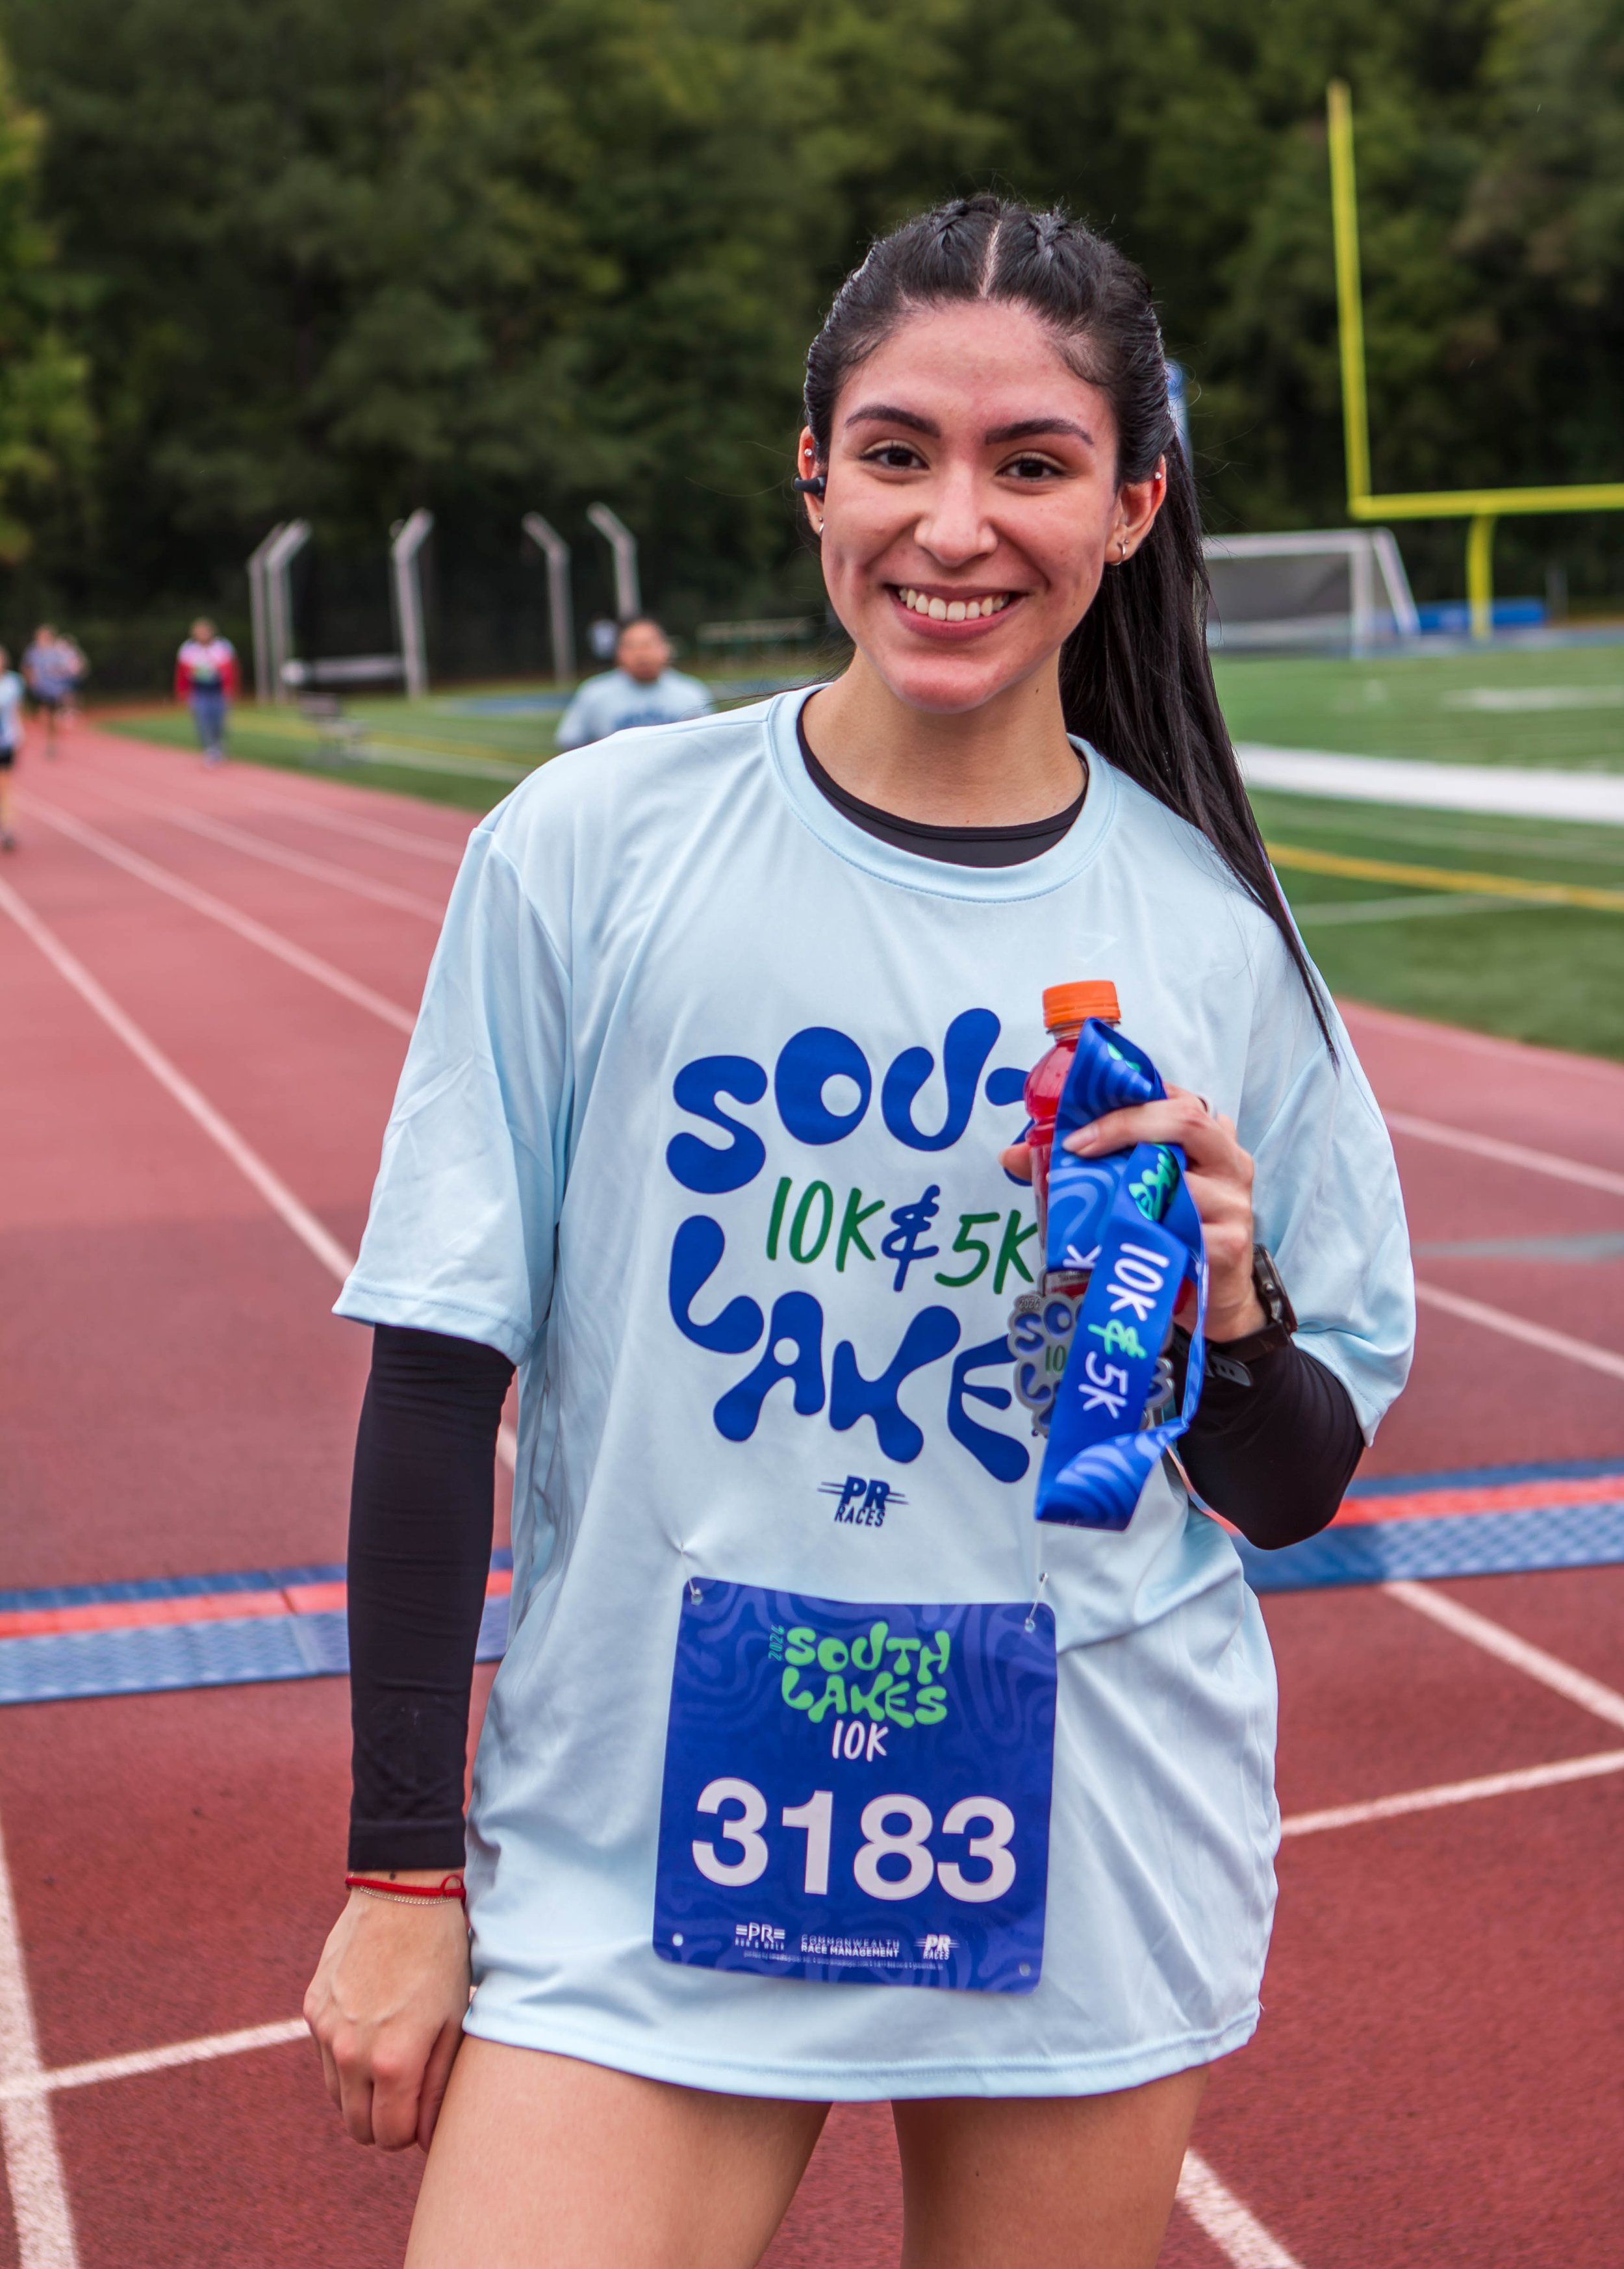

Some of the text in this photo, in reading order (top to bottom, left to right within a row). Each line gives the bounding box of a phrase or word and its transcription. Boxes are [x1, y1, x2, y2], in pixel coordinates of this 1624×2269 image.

[767, 1177, 1038, 1295] 10K & 5K
[1106, 1242, 1169, 1322] 10K
[1087, 1319, 1148, 1359] &
[1078, 1351, 1129, 1419] 5K
[841, 1475, 891, 1511] PR
[834, 1504, 886, 1527] RACES
[768, 1624, 785, 1661] 2026
[785, 1621, 950, 1685] SOUTH
[781, 1666, 947, 1728] LAKES
[832, 1719, 889, 1762] 10K
[692, 1776, 1017, 1903] 3183
[748, 1922, 774, 1943] PR
[800, 1944, 900, 1958] RACE MANAGEMENT
[801, 1934, 900, 1948] COMMONWEALTH
[924, 1934, 951, 1952] PR
[922, 1951, 950, 1960] RACES
